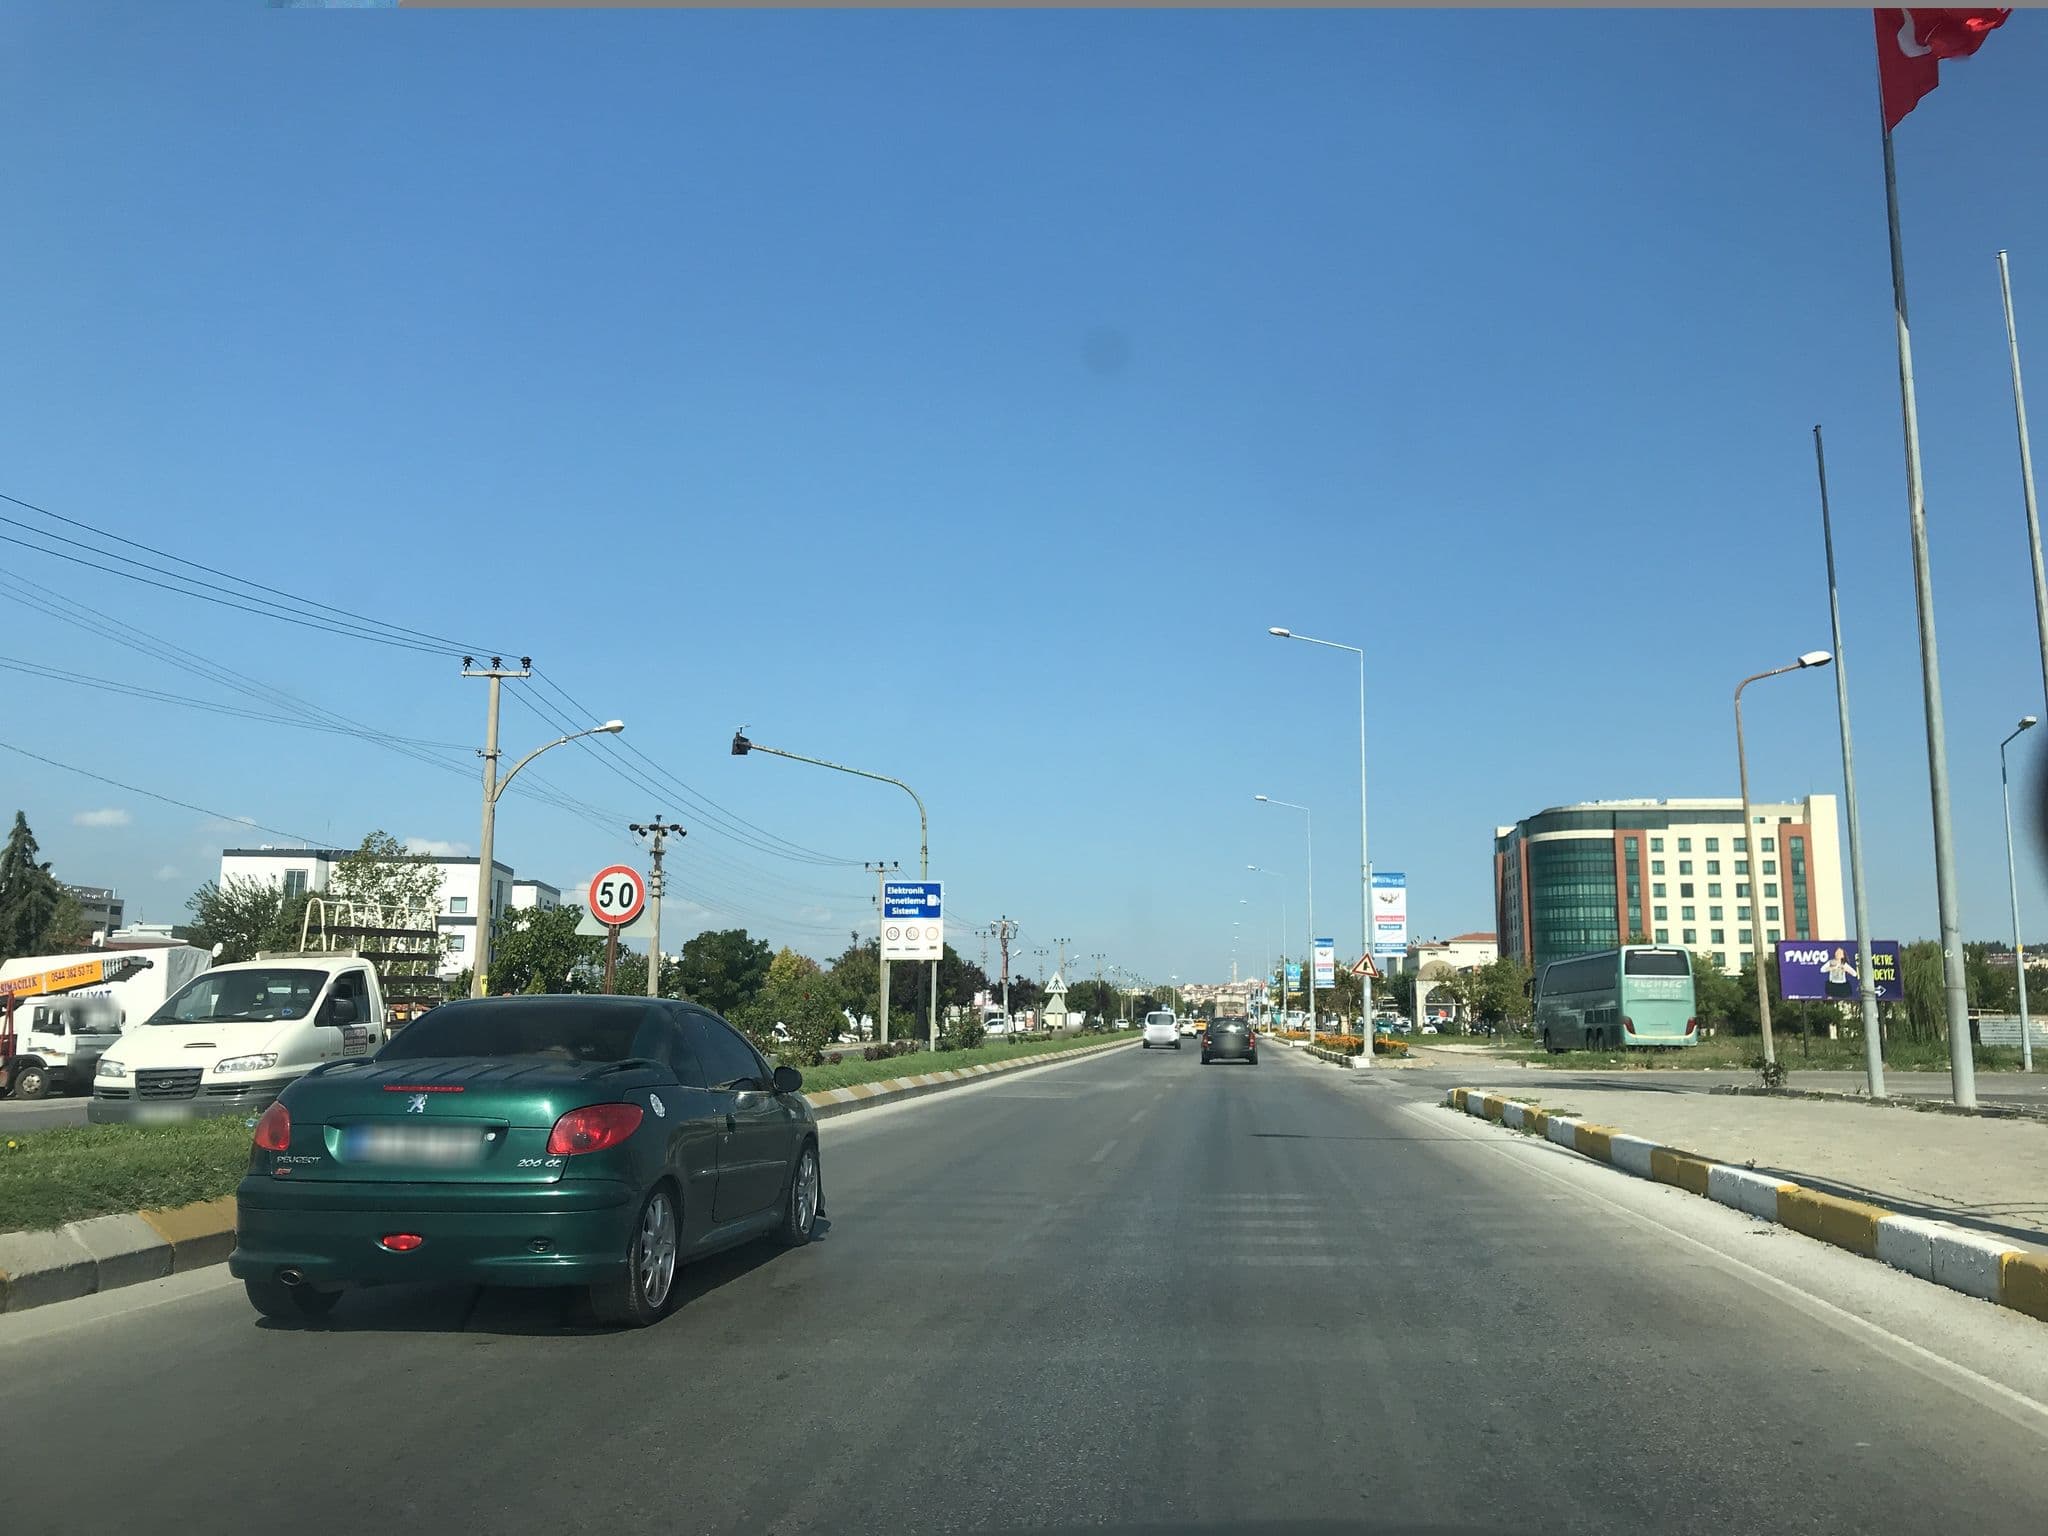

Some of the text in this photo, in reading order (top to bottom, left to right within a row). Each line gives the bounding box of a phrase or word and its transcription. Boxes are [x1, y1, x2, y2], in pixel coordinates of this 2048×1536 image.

[887, 886, 925, 894] Elektronik
[600, 882, 634, 908] 50
[885, 897, 926, 905] Denetleme
[892, 907, 919, 915] Sistemi
[276, 1156, 321, 1164] PEUGEOT
[517, 1158, 543, 1168] 206
